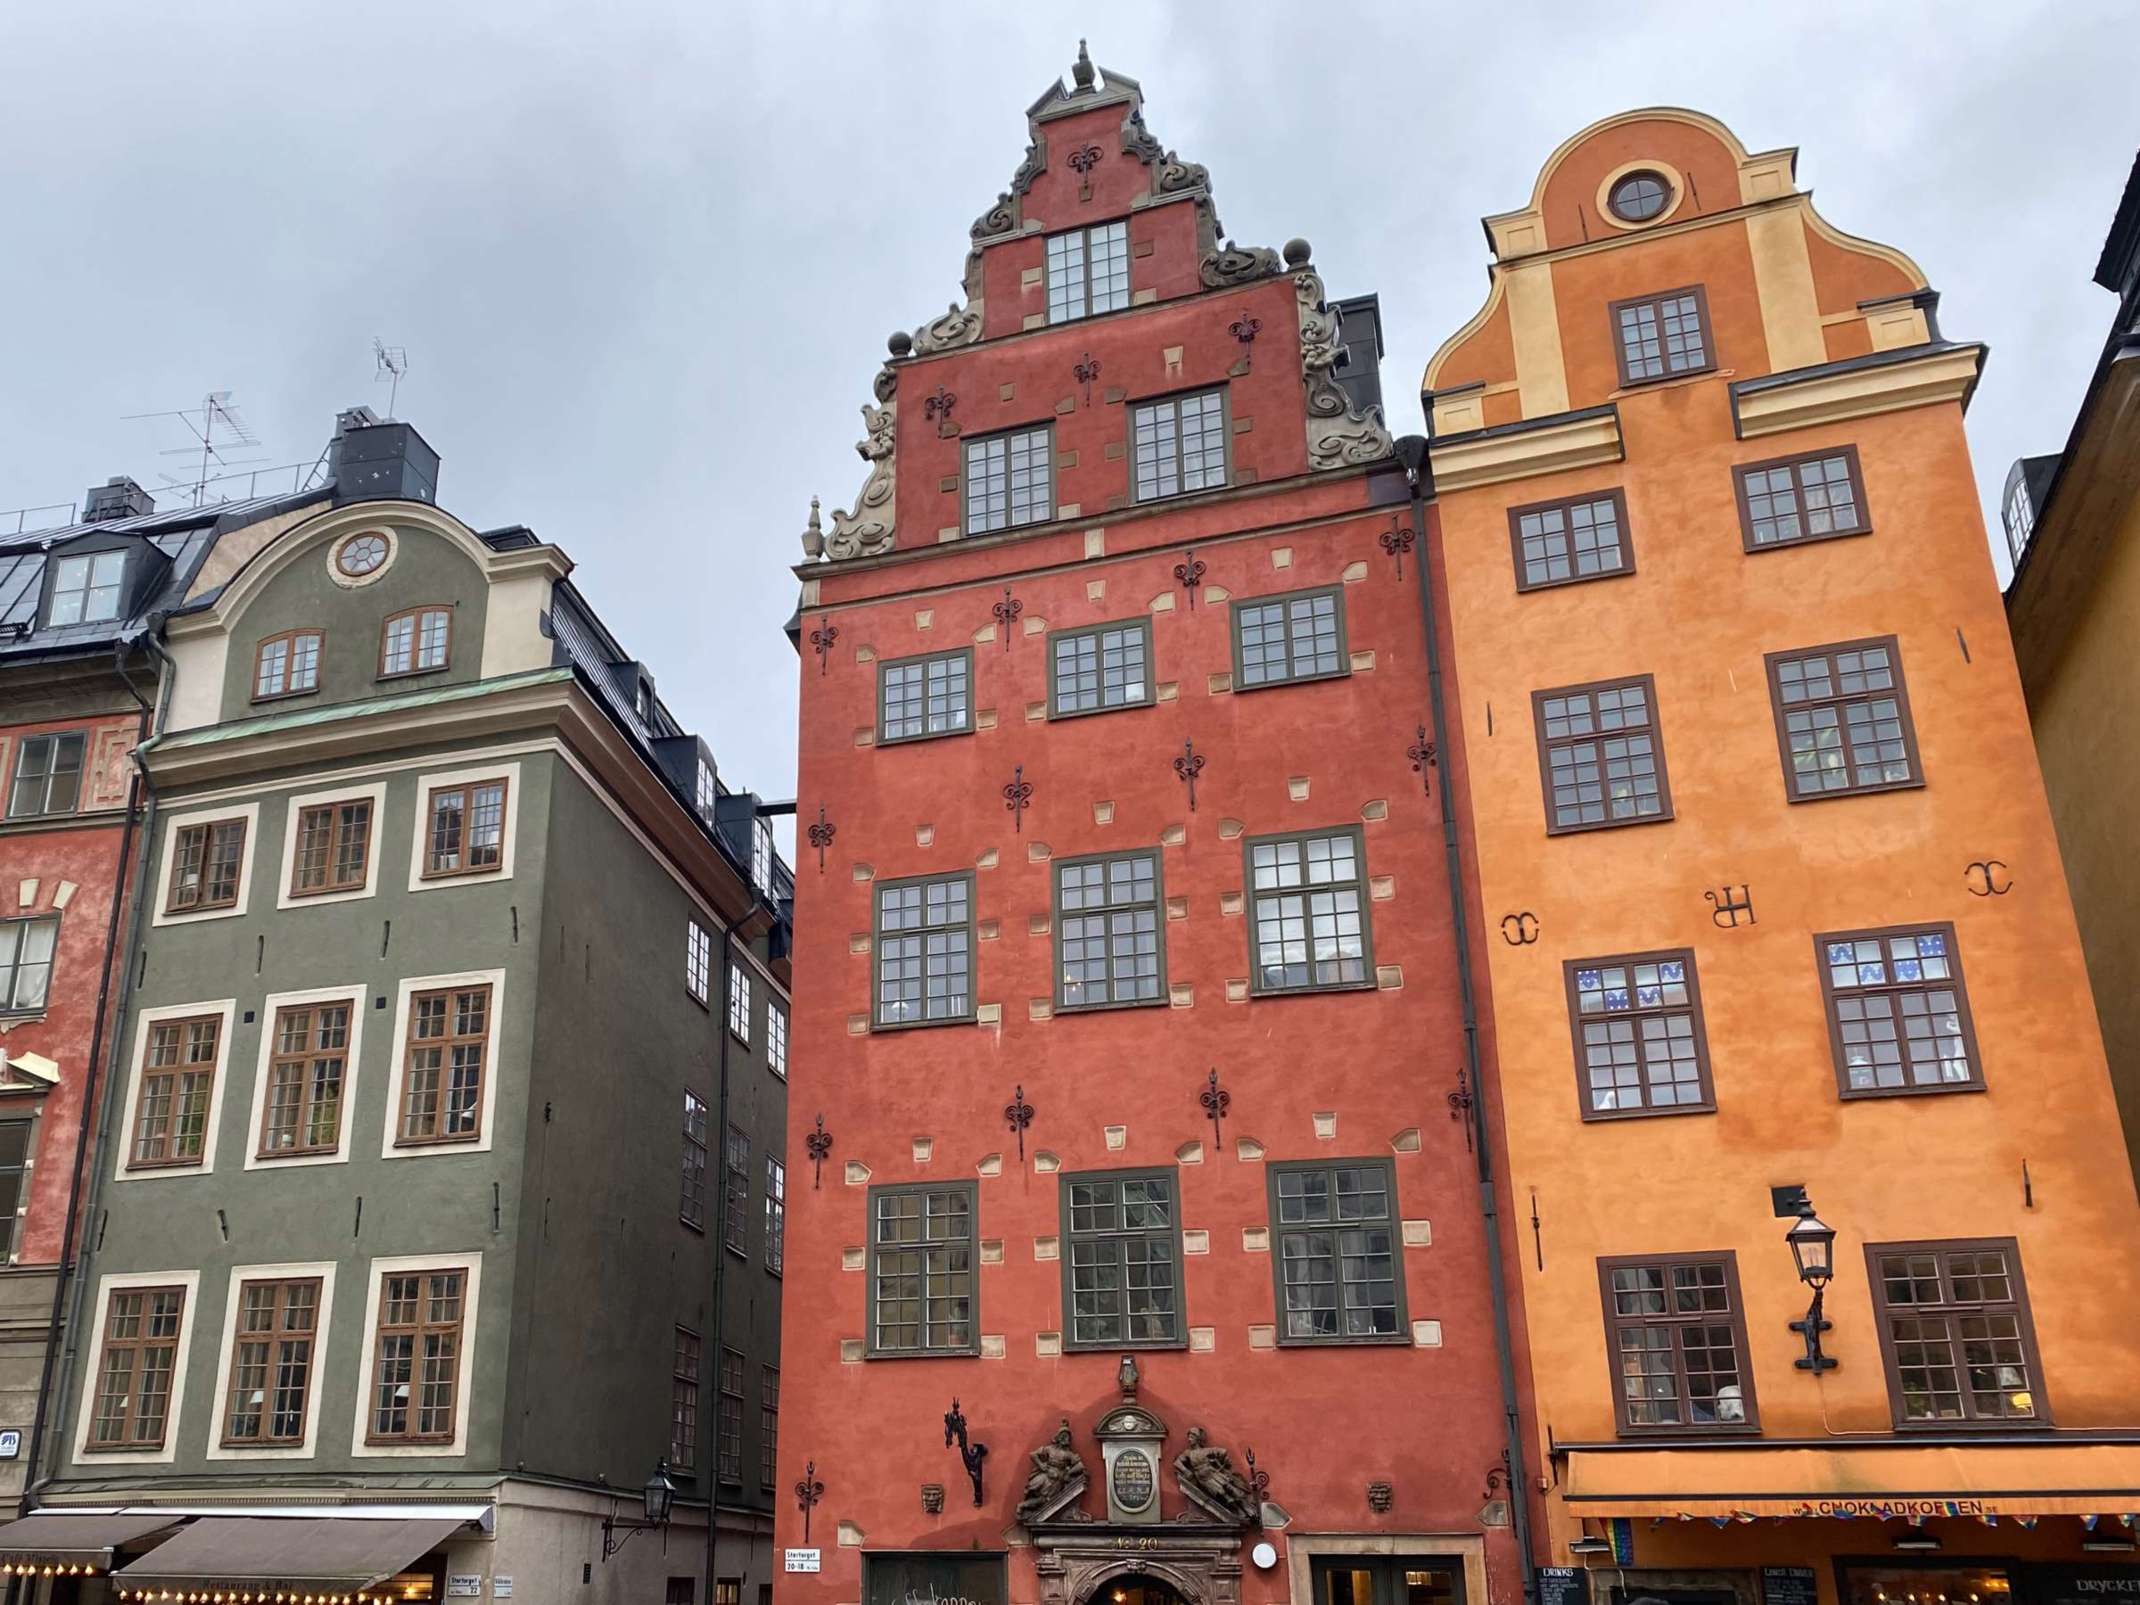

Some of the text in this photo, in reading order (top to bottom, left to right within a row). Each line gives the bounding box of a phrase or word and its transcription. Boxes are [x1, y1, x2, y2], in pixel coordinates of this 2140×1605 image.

[1138, 1537, 1158, 1552] 20
[787, 1551, 817, 1560] Stortorget
[1543, 1567, 1575, 1577] DRINKS
[2076, 1579, 2140, 1593] DRYCKE
